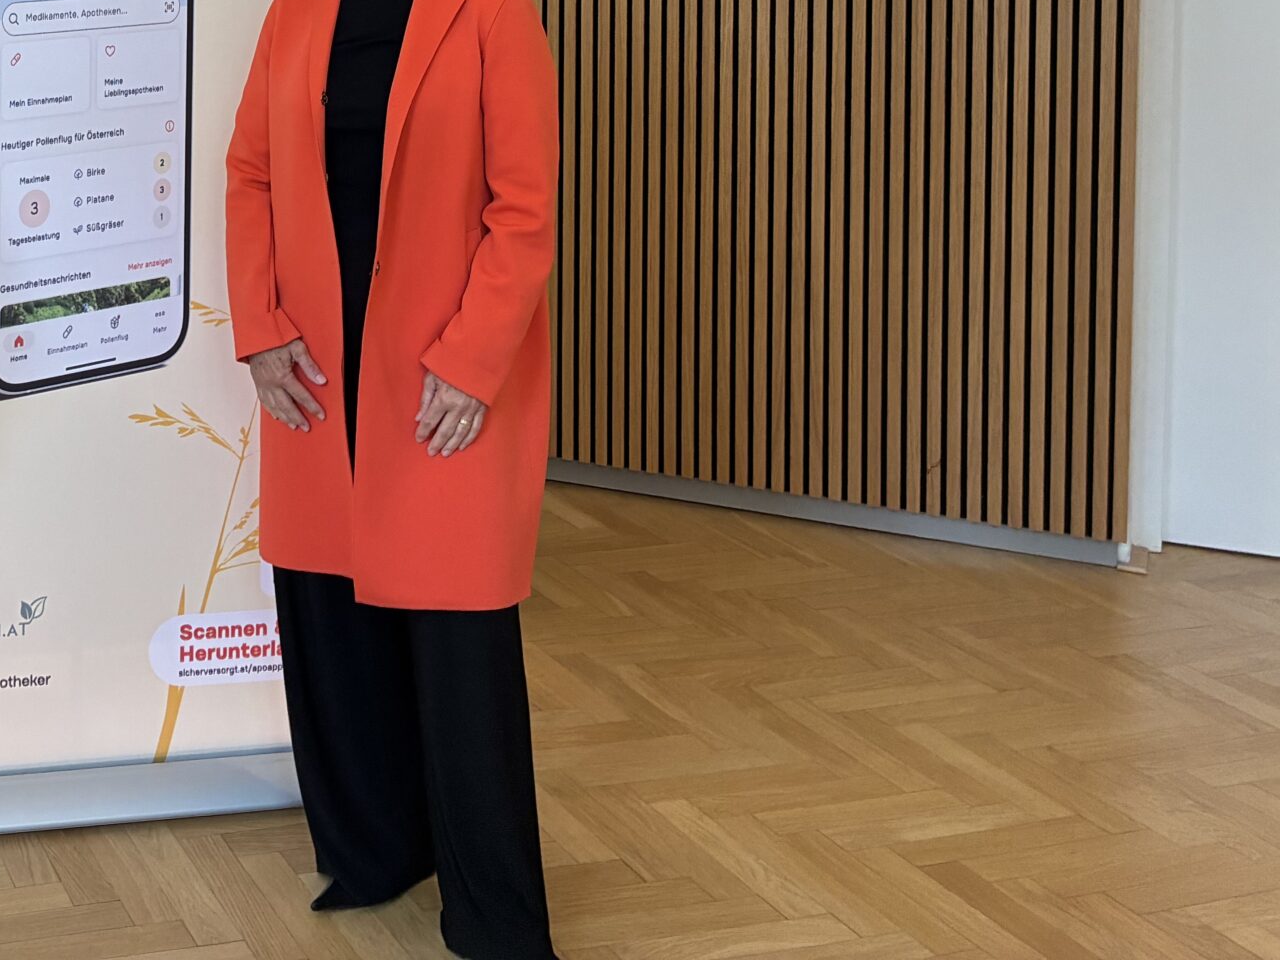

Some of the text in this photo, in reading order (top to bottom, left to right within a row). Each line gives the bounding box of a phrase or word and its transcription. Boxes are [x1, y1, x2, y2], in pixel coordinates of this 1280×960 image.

[25, 7, 127, 22] Medikamente, Apotheken...
[104, 78, 123, 86] Meine
[104, 85, 163, 98] Lieblingsapotheken
[10, 95, 72, 108] Mein Einnahmeplan
[1, 128, 124, 151] Heutiger Pollenflug für Österreich
[159, 159, 164, 167] 2
[87, 168, 105, 177] Birke
[20, 174, 50, 185] Maximale
[159, 186, 164, 194] 3
[87, 194, 114, 205] Platane
[31, 202, 39, 215] 3
[86, 219, 124, 232] Süßgräser
[8, 232, 60, 247] Tagesbelastung
[128, 257, 172, 271] Mehr anzeigen
[0, 271, 91, 294] Gesundheitsnachrichten
[153, 326, 167, 334] Mehr
[100, 334, 128, 345] Pollenflug
[47, 341, 88, 355] Einnahmeplan
[10, 354, 28, 363] Home
[180, 622, 268, 641] Scannen
